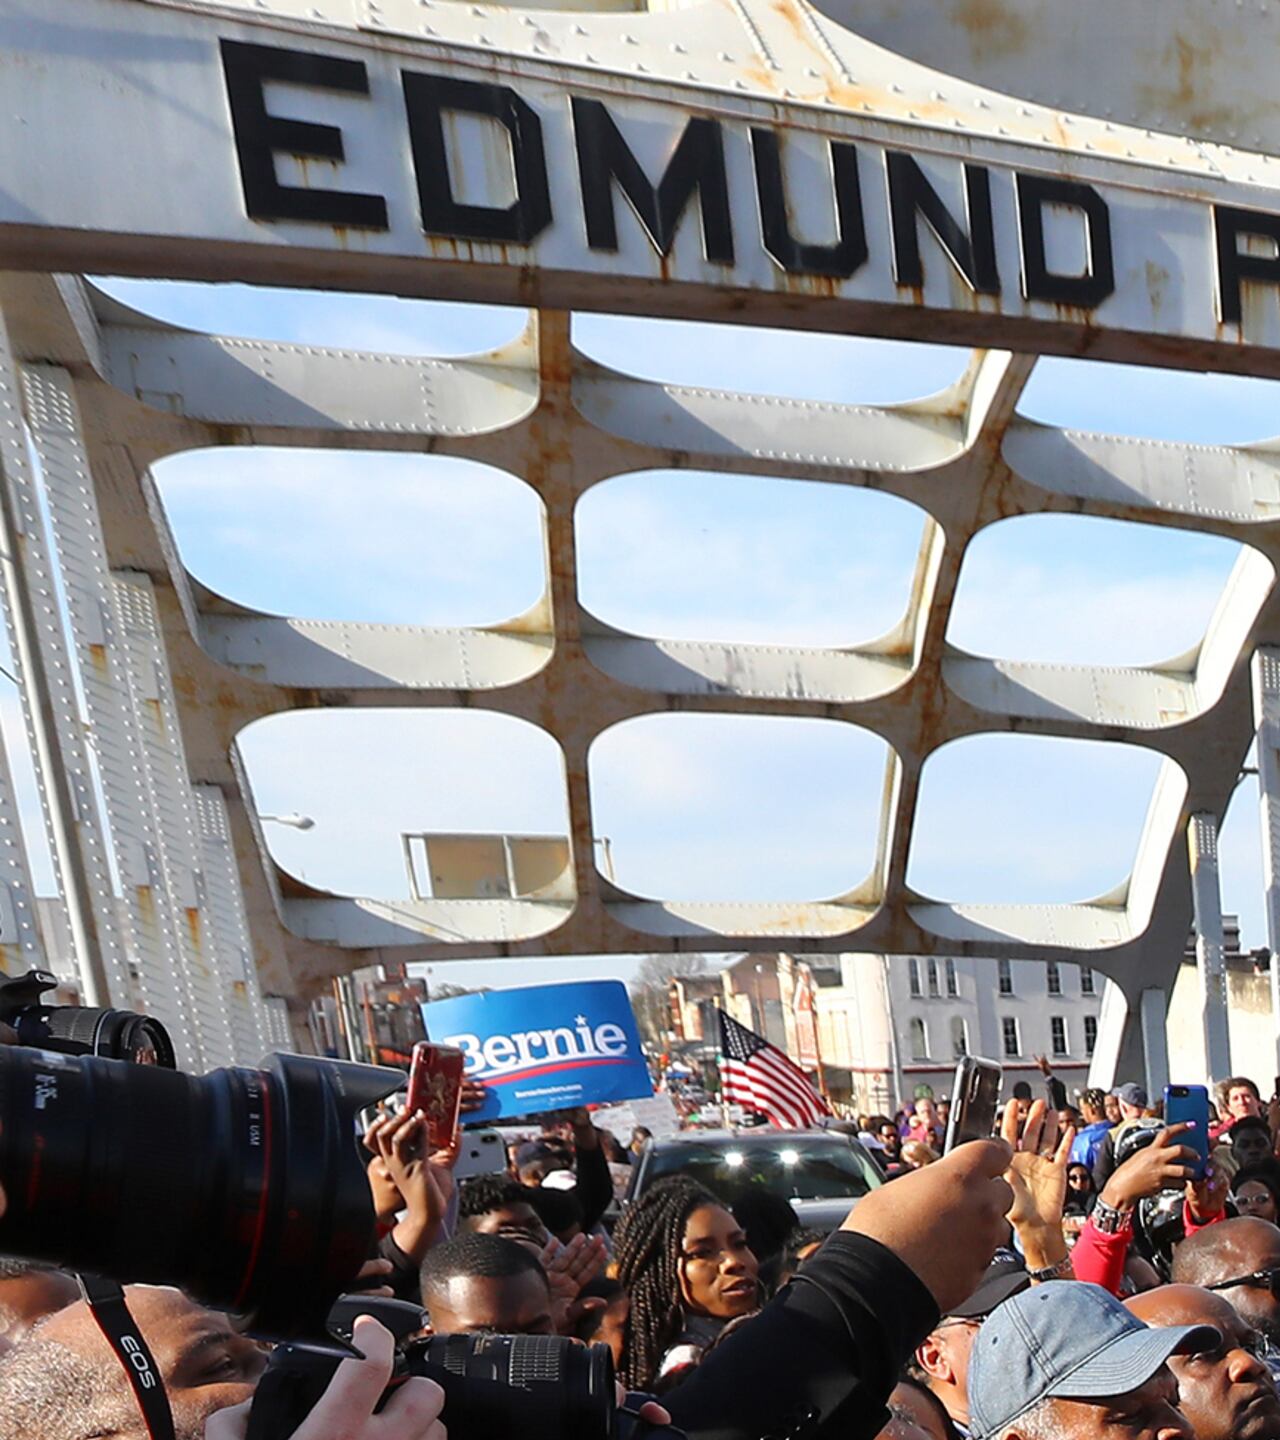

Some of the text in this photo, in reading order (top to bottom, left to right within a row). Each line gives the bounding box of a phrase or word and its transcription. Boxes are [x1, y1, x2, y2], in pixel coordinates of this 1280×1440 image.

[219, 37, 1117, 312] EDMUND
[443, 1014, 628, 1075] Bernie
[120, 1335, 156, 1389] EOS
